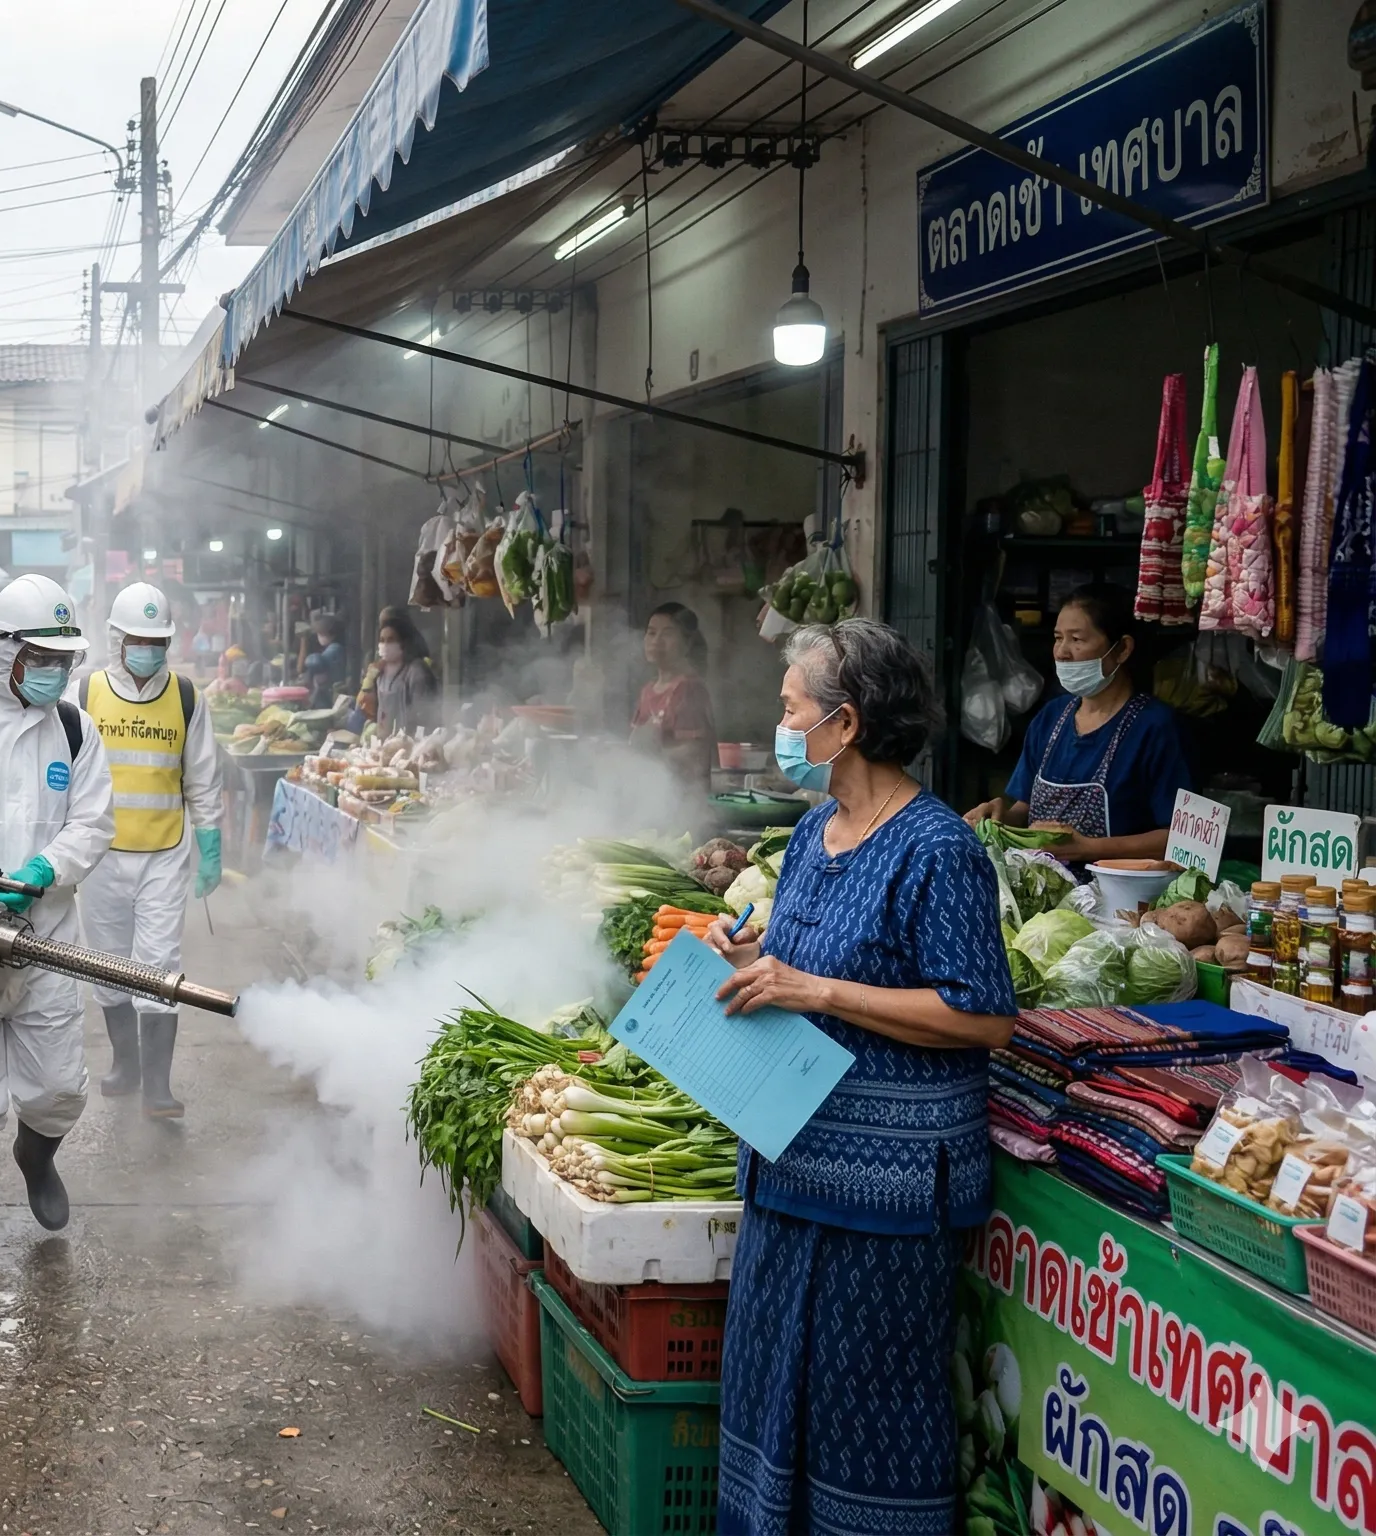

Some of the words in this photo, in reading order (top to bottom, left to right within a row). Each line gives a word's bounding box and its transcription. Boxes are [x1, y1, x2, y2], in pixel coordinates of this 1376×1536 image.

[1079, 84, 1243, 216] เทศบาล
[1267, 809, 1353, 871] ผักสด
[1044, 1366, 1189, 1536] ผักสด
